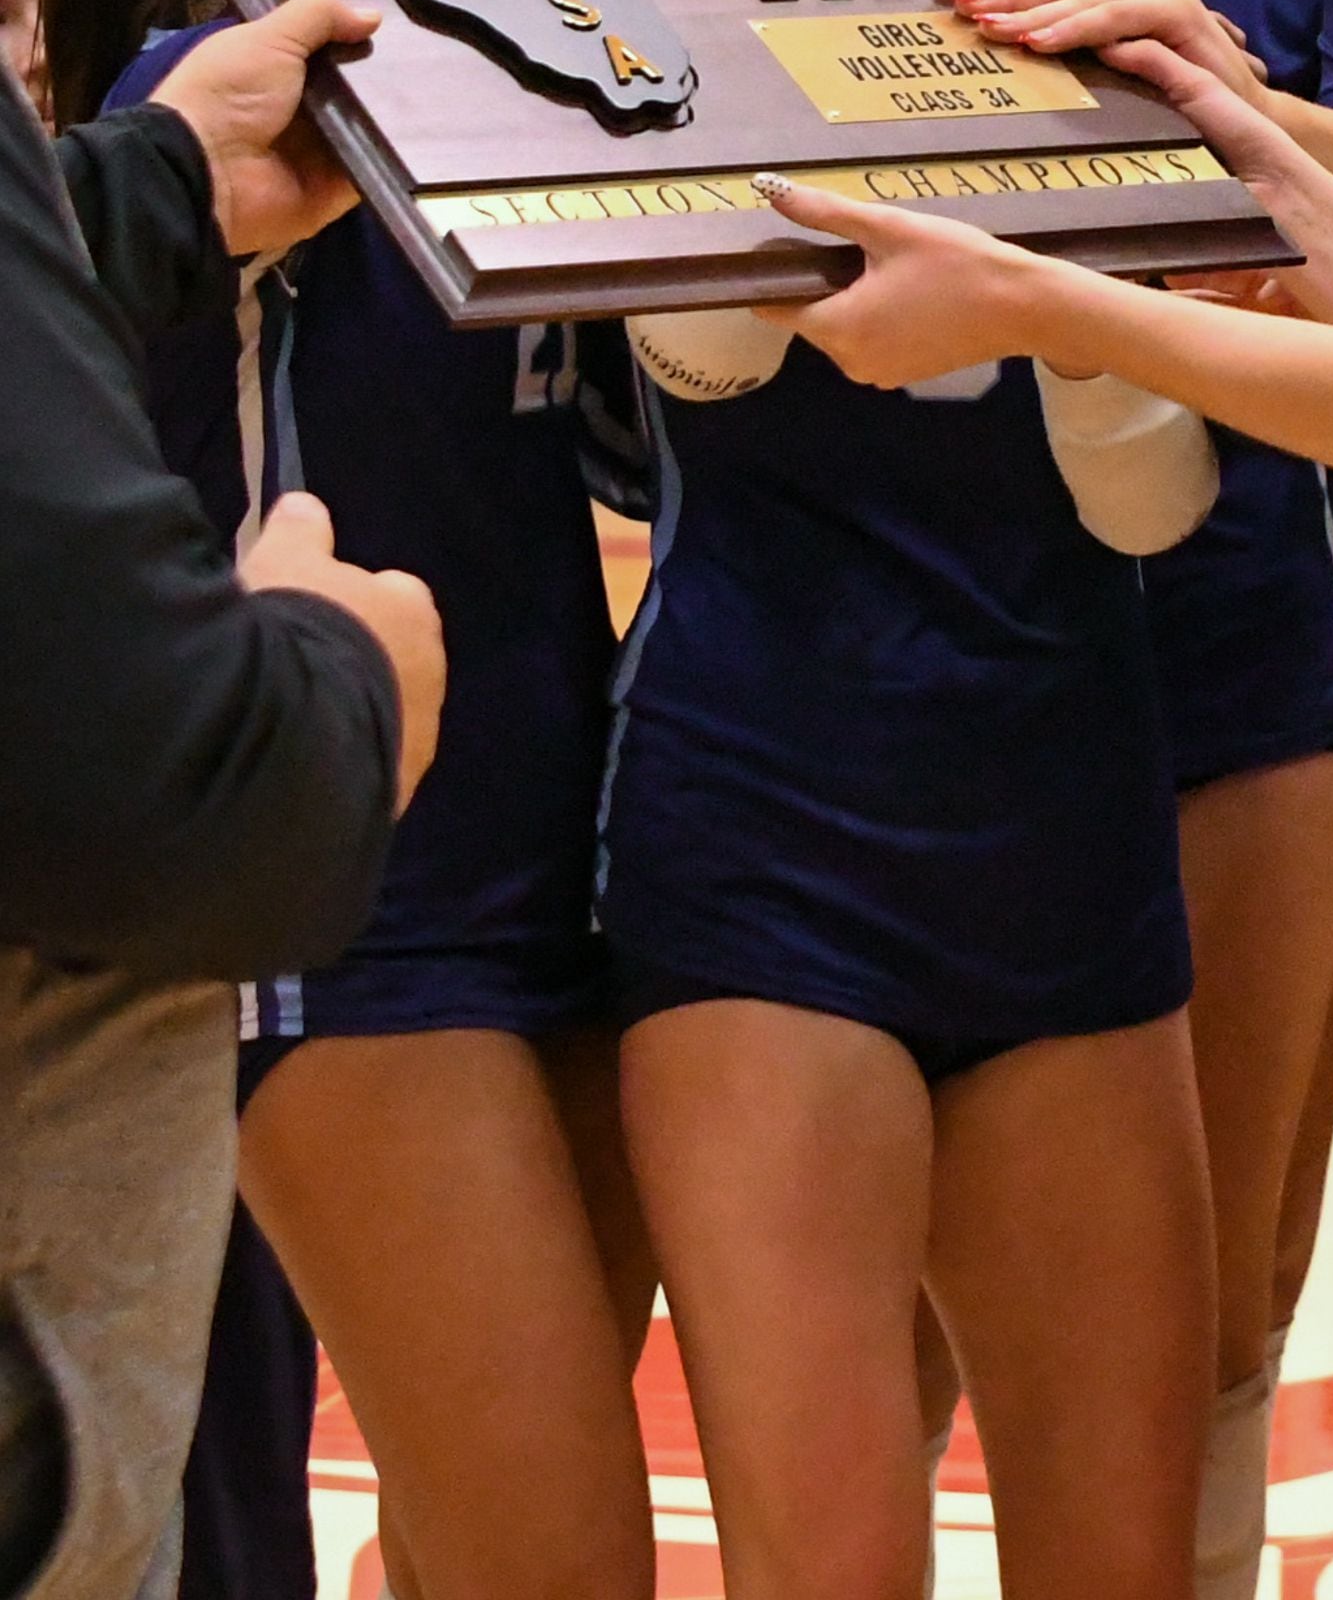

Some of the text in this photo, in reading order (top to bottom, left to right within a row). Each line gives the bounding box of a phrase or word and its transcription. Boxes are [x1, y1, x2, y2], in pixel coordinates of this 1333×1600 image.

[858, 21, 944, 48] GIRLS
[838, 49, 1013, 82] VOLLEYBALL
[890, 86, 1020, 113] CLASS 3A
[864, 152, 1196, 200] CHAMPIONS
